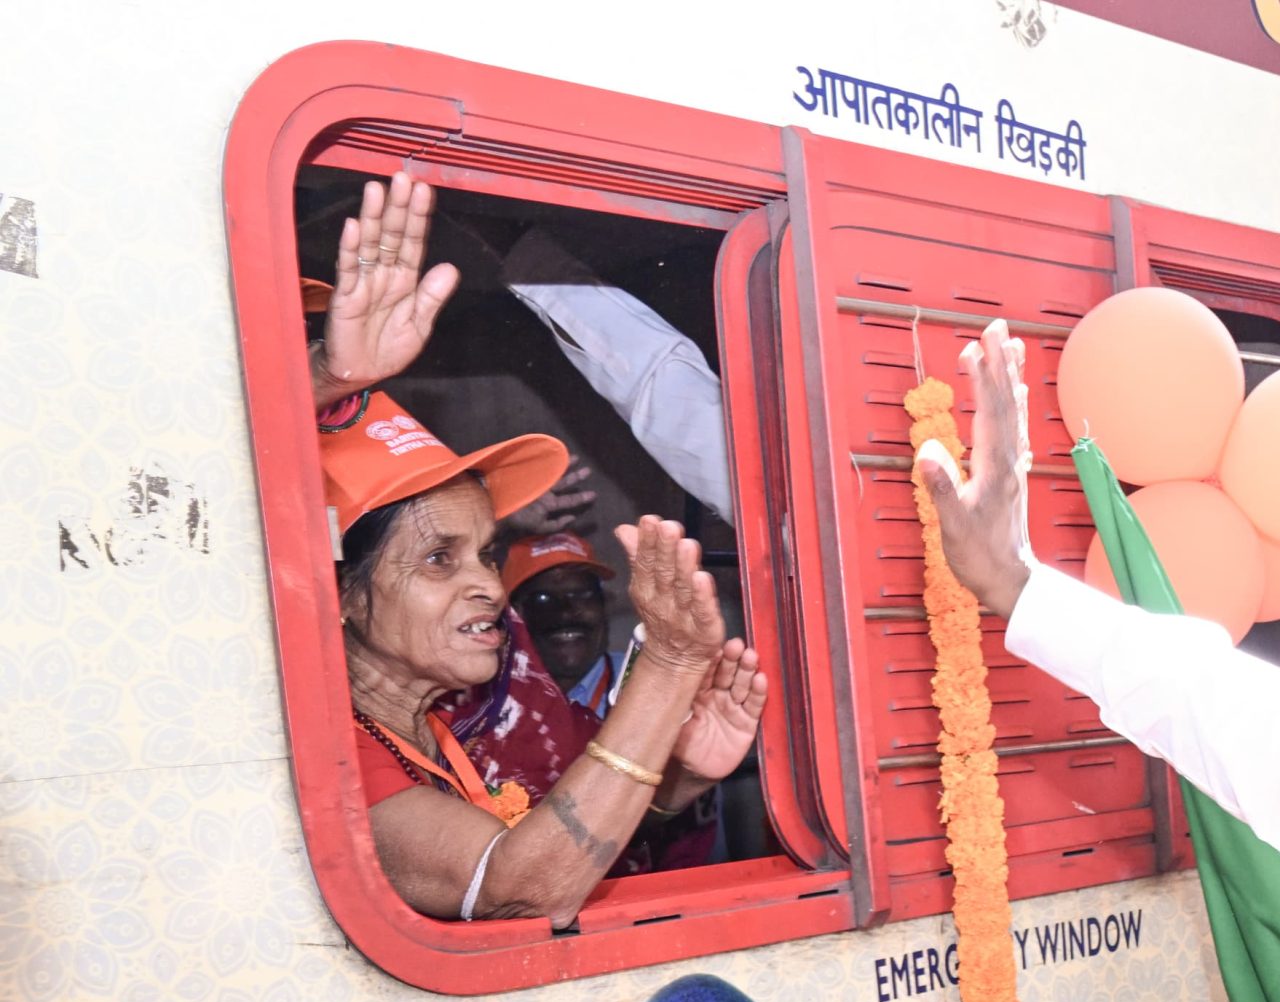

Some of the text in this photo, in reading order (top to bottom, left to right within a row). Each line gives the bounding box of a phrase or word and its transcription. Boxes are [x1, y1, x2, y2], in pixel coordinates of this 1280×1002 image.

[793, 65, 1087, 181] आपातकालीन खिड़की
[875, 908, 1142, 1002] EMERGY WINDOW
